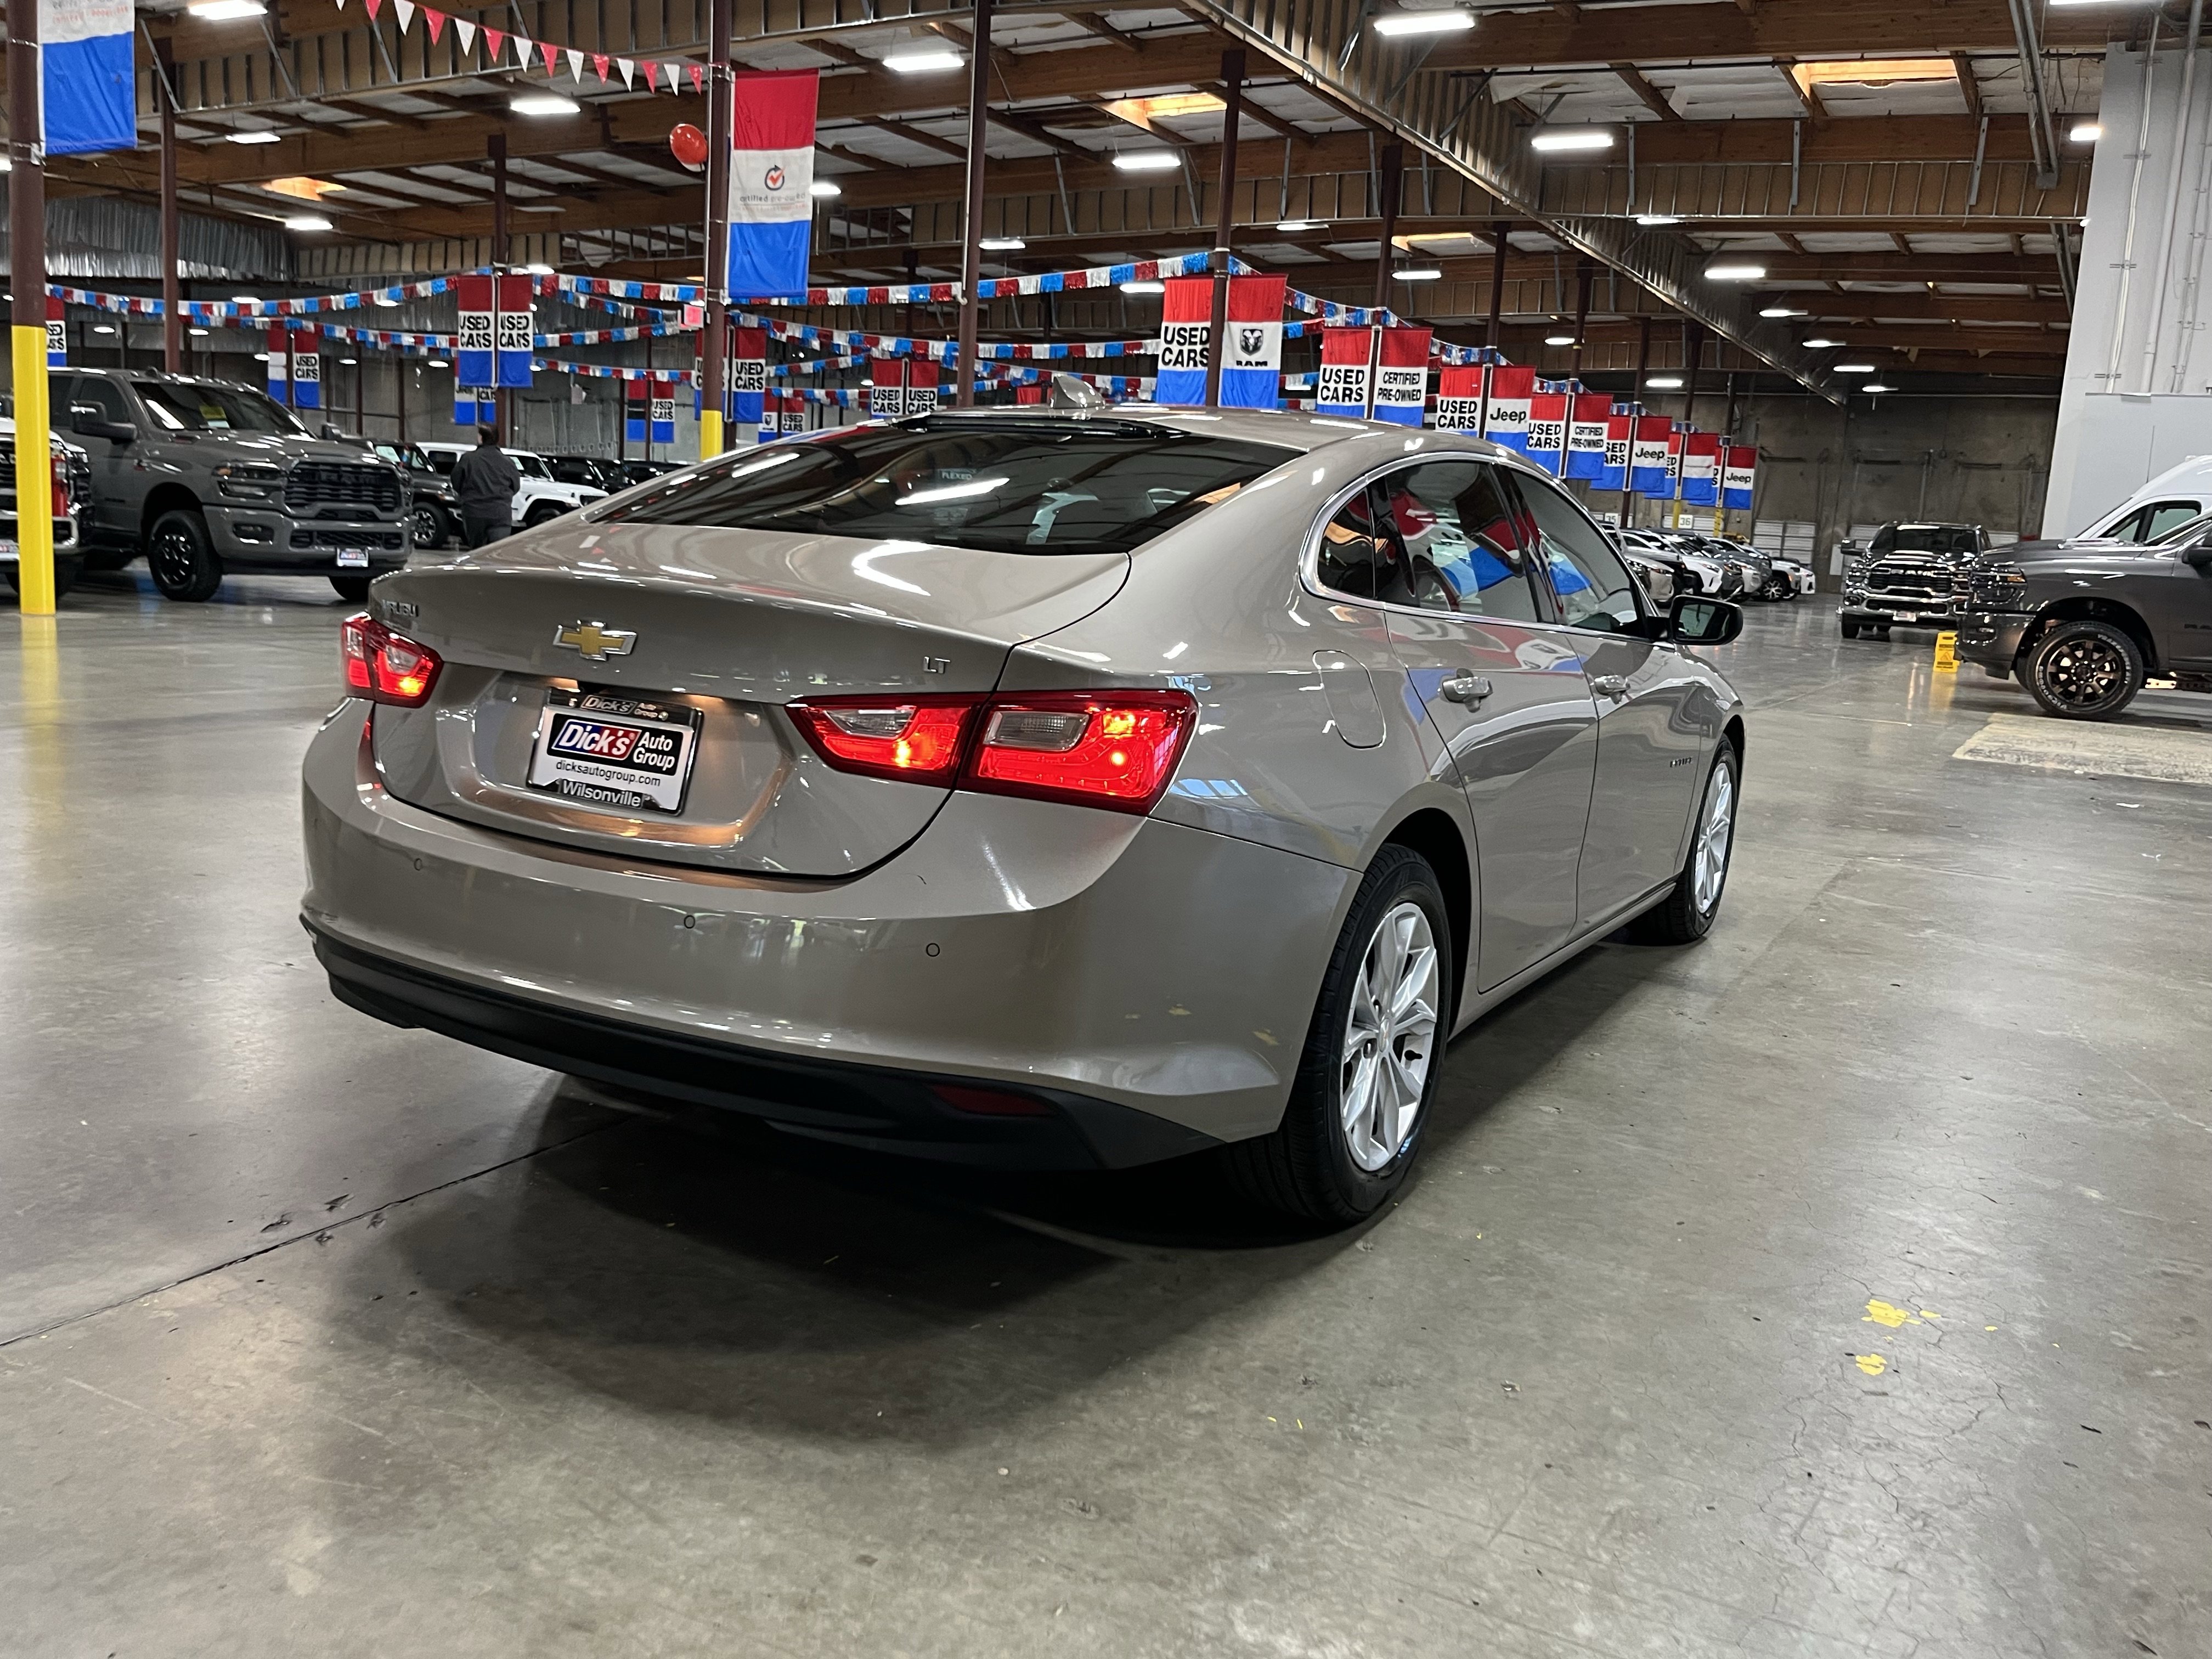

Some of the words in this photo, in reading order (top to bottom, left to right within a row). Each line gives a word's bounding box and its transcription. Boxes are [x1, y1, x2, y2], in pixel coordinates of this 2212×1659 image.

[460, 315, 490, 330] USED
[500, 315, 529, 330] USED
[460, 332, 492, 348] CARS
[500, 332, 530, 348] CARS
[1164, 326, 1211, 346] USED
[1161, 347, 1209, 367] CARS
[736, 362, 764, 375] USED
[735, 376, 764, 390] CARS
[1322, 368, 1364, 385] USED
[1383, 371, 1420, 385] CERTIFIED
[873, 389, 900, 401] USED
[909, 390, 936, 402] USED
[1321, 385, 1363, 402] CARS
[1377, 387, 1421, 402] PRE-OWNED
[873, 401, 900, 413] CARS
[907, 402, 935, 413] CARS
[1440, 400, 1477, 414] USED
[1437, 415, 1476, 429] CARS
[1490, 408, 1526, 424] Jeep
[1528, 423, 1561, 435] USED
[1527, 436, 1560, 448] CARS
[1605, 442, 1626, 453] SED
[1604, 454, 1625, 464] ARS
[1635, 448, 1665, 461] Jeep
[1726, 473, 1751, 484] Jeep
[1680, 517, 1691, 526] 36
[923, 656, 951, 674] LT
[585, 697, 631, 712] Dick's
[559, 724, 630, 755] Dick's
[638, 732, 673, 751] Auto
[633, 747, 675, 771] Group
[556, 760, 661, 787] dicksautogroup.com
[562, 780, 642, 808] Wilsonville
